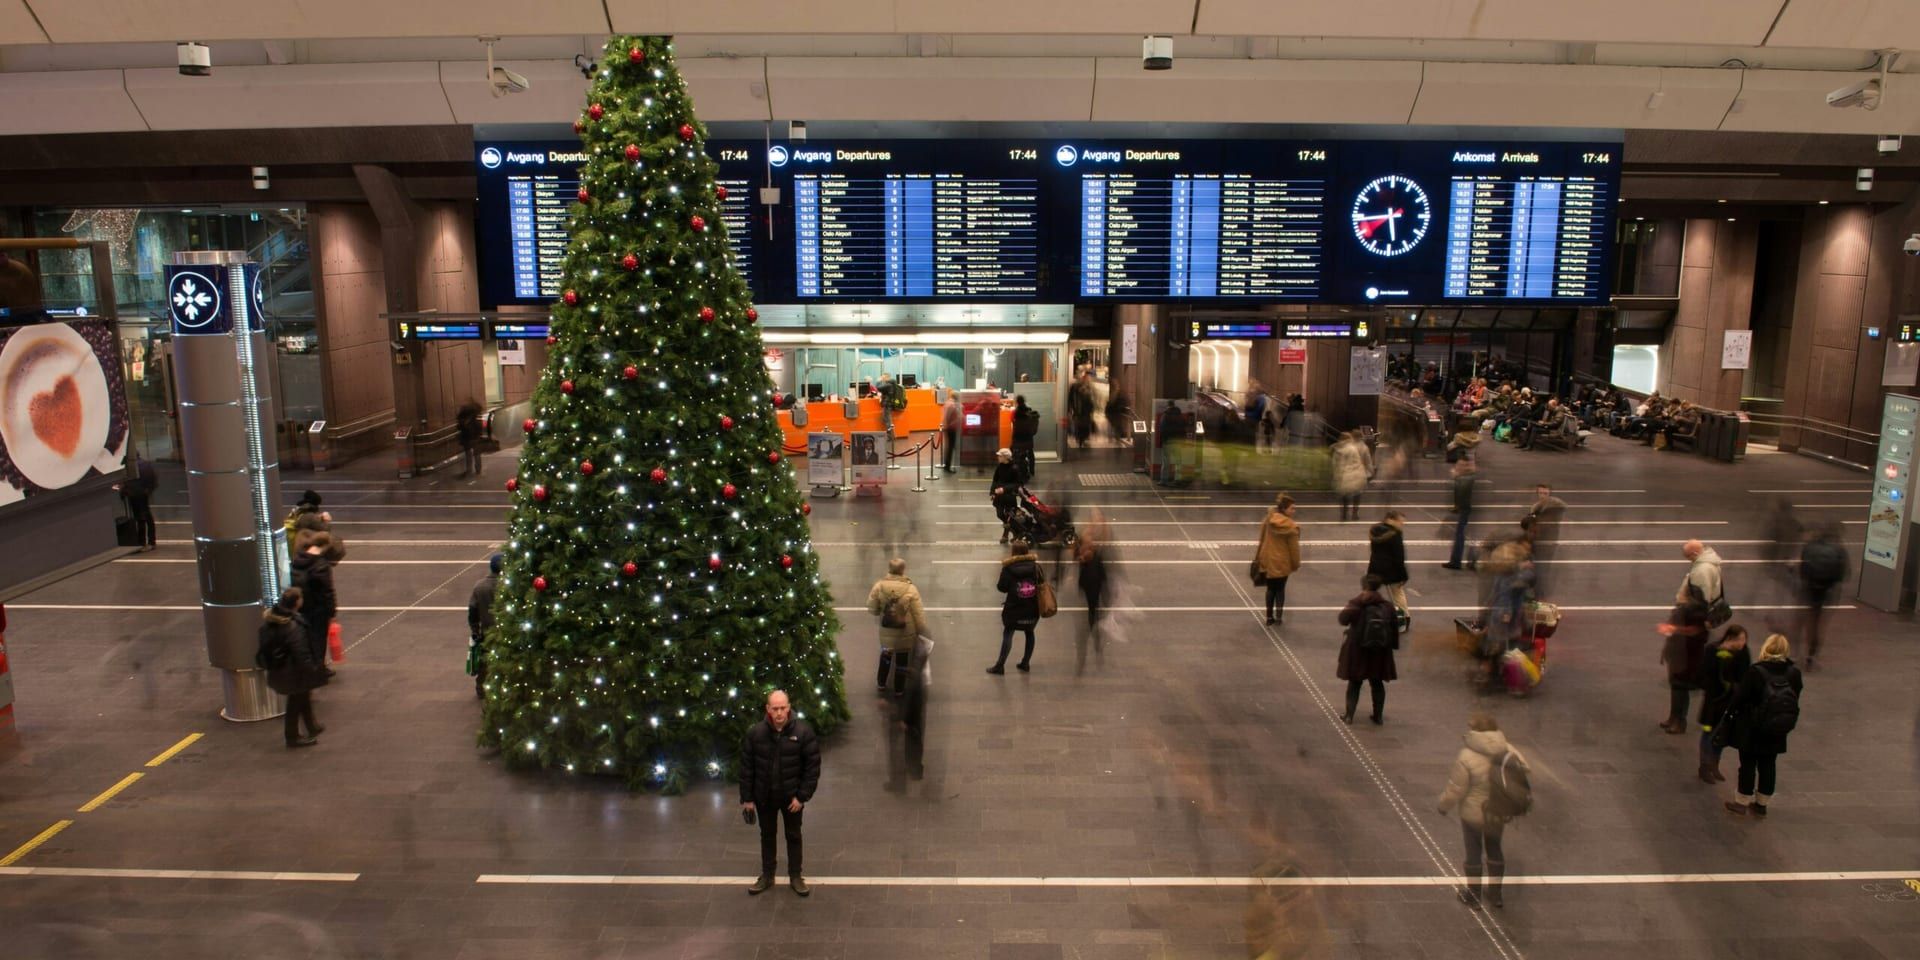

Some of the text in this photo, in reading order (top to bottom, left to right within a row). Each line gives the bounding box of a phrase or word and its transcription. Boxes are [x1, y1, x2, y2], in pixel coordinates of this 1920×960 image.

[507, 152, 544, 163] Avgang
[720, 149, 748, 160] 17:44
[793, 149, 1037, 162] Avgang Departures 17:44
[1082, 150, 1326, 162] Avgang Departures 17:44
[1453, 152, 1610, 164] Ankomst Arrivals 17:44
[402, 330, 408, 339] 7
[1192, 328, 1199, 337] 9
[1357, 328, 1368, 337] 10
